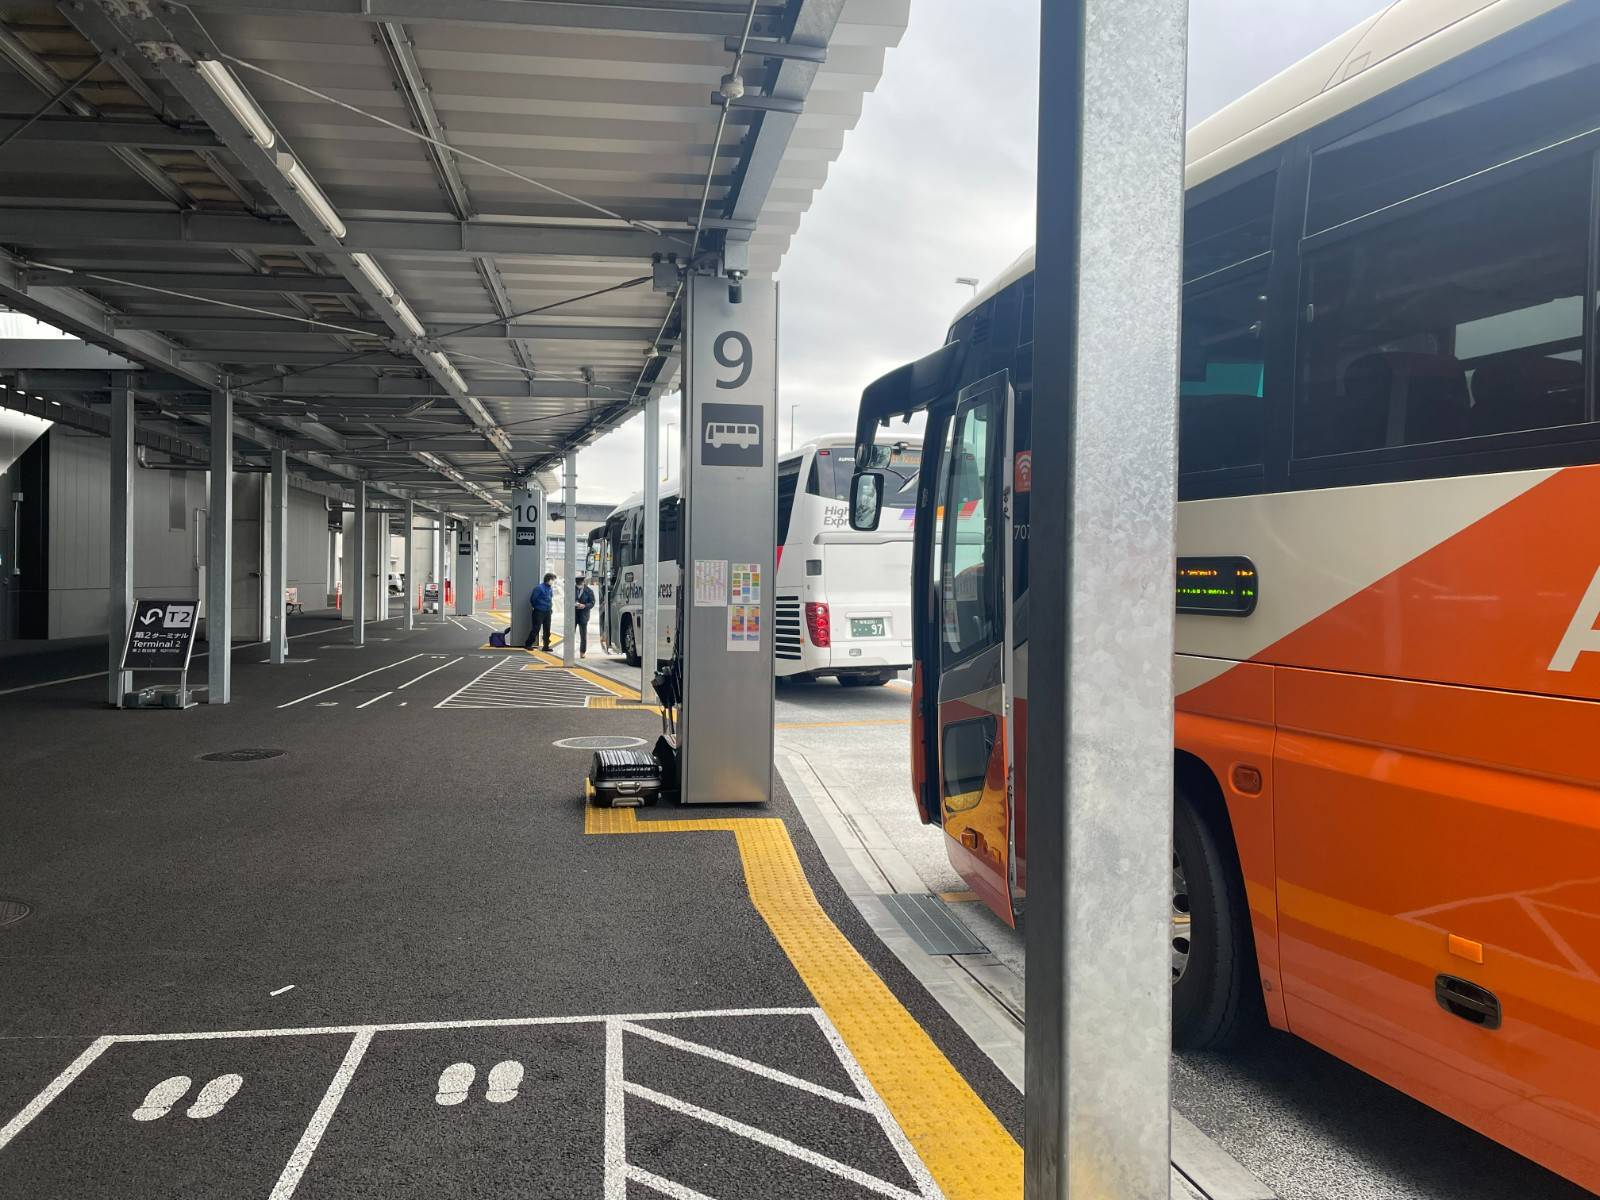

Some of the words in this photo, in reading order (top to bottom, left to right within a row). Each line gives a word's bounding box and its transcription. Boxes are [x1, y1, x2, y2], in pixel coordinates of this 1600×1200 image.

[713, 330, 753, 390] 9
[514, 504, 539, 523] 10
[824, 506, 850, 518] High
[823, 516, 850, 529] Expr
[459, 531, 472, 542] 11
[168, 611, 190, 623] T2
[134, 631, 189, 639] 第2ターミナル
[871, 623, 883, 635] 97
